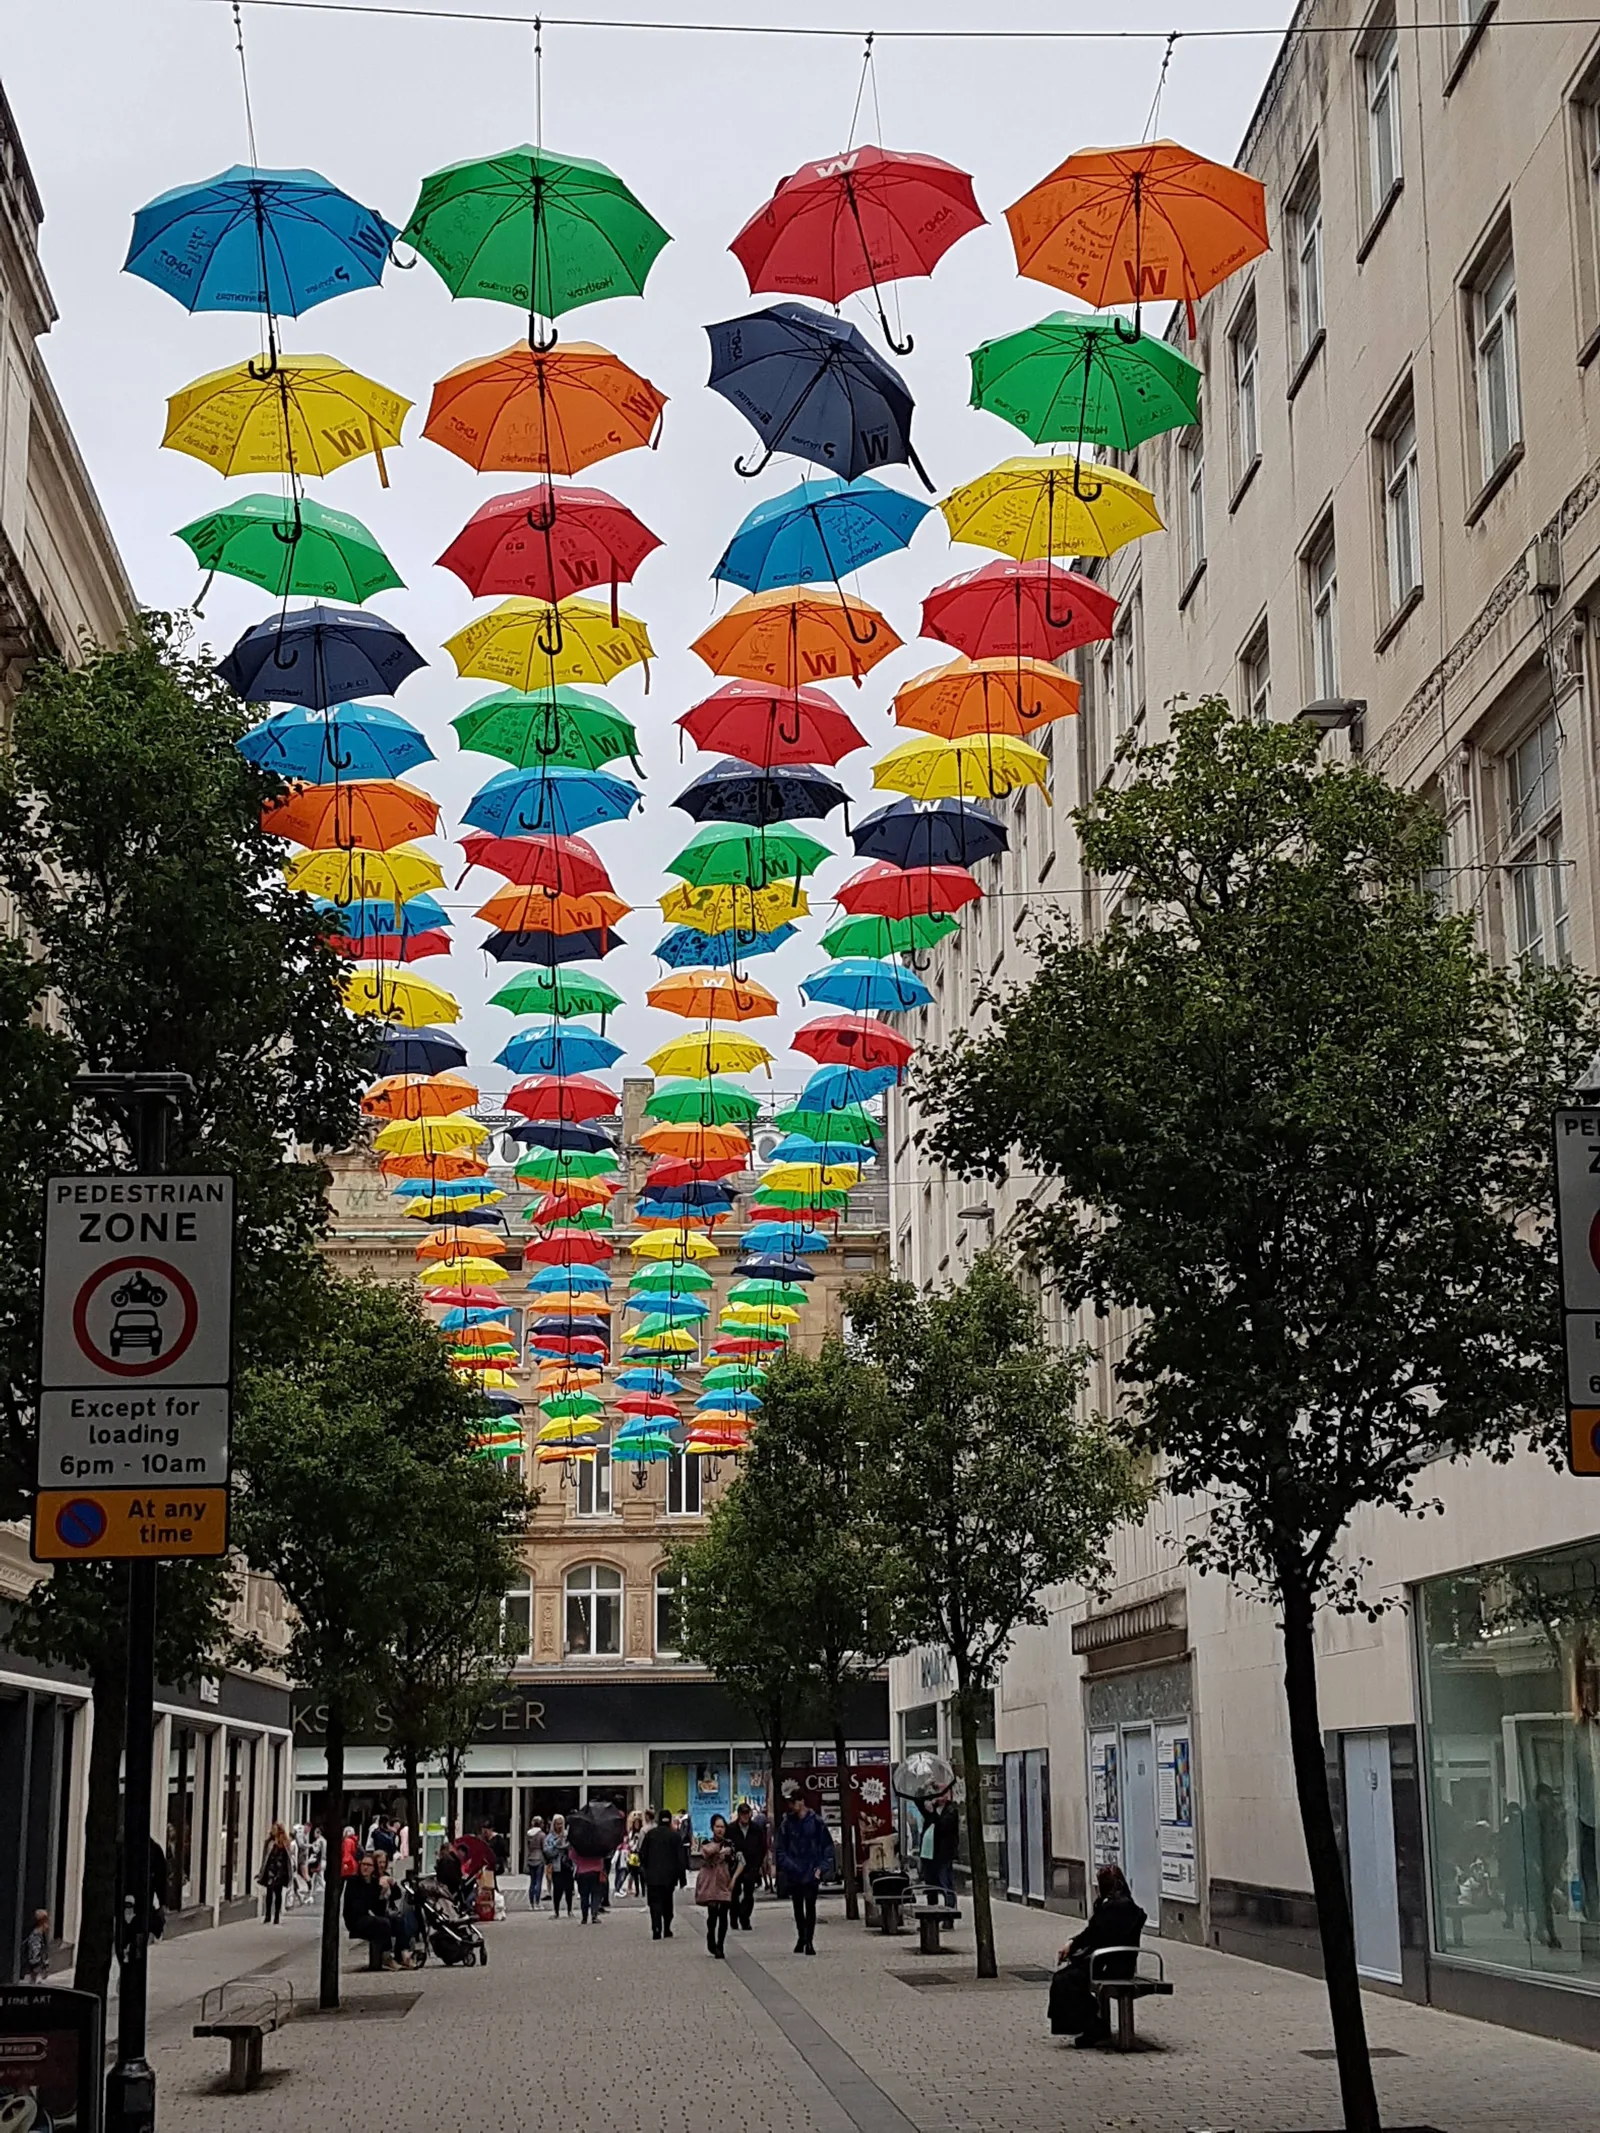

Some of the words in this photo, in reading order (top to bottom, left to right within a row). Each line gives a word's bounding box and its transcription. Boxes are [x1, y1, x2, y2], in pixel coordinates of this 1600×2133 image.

[816, 152, 860, 178] W
[1124, 259, 1166, 297] W
[321, 427, 366, 457] W
[861, 429, 888, 465] W
[560, 559, 599, 586] W
[597, 640, 632, 666] W
[801, 650, 836, 676] W
[590, 735, 619, 757] W
[912, 800, 941, 813] W
[763, 858, 789, 877] W
[354, 876, 381, 898] W
[566, 909, 592, 927] W
[572, 996, 594, 1012] W
[721, 1104, 741, 1119] W
[1565, 1118, 1600, 1136] PE
[57, 1183, 223, 1204] PEDESTRIAN
[79, 1212, 197, 1242] ZONE
[71, 1400, 156, 1419] Except
[166, 1397, 200, 1416] for
[89, 1423, 179, 1446] loading
[60, 1456, 114, 1477] 6pm
[141, 1455, 206, 1474] 10am
[129, 1500, 156, 1518] At
[164, 1500, 206, 1521] any
[139, 1525, 193, 1543] time
[374, 1701, 546, 1733] SCER
[805, 1773, 859, 1790] CRES
